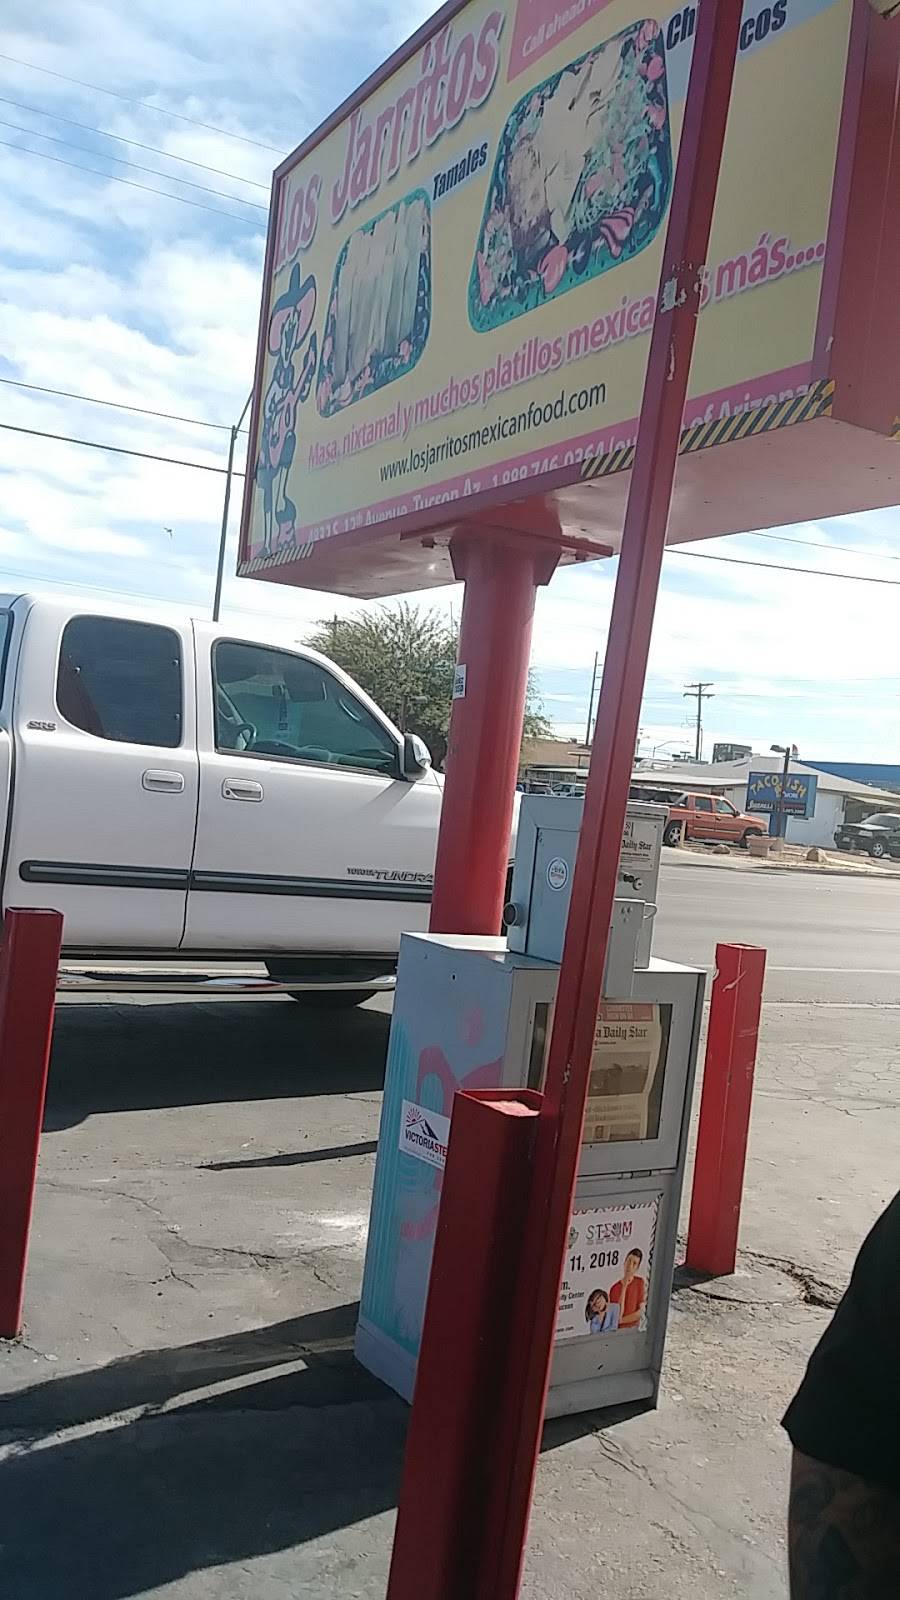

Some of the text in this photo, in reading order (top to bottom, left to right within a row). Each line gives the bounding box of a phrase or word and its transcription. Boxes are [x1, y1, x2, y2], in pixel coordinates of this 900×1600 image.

[330, 10, 505, 224] Jarritos
[432, 142, 488, 200] Tamales
[342, 400, 400, 456] nixtamal
[414, 376, 480, 426] muchos
[482, 334, 562, 405] platillos
[380, 382, 606, 482] www.losjarritosmexicanfood.com
[602, 1025, 627, 1041] Daily
[629, 1025, 649, 1039] Star
[404, 1128, 448, 1157] VICTORIASTE
[569, 1249, 620, 1274] 11, 2018
